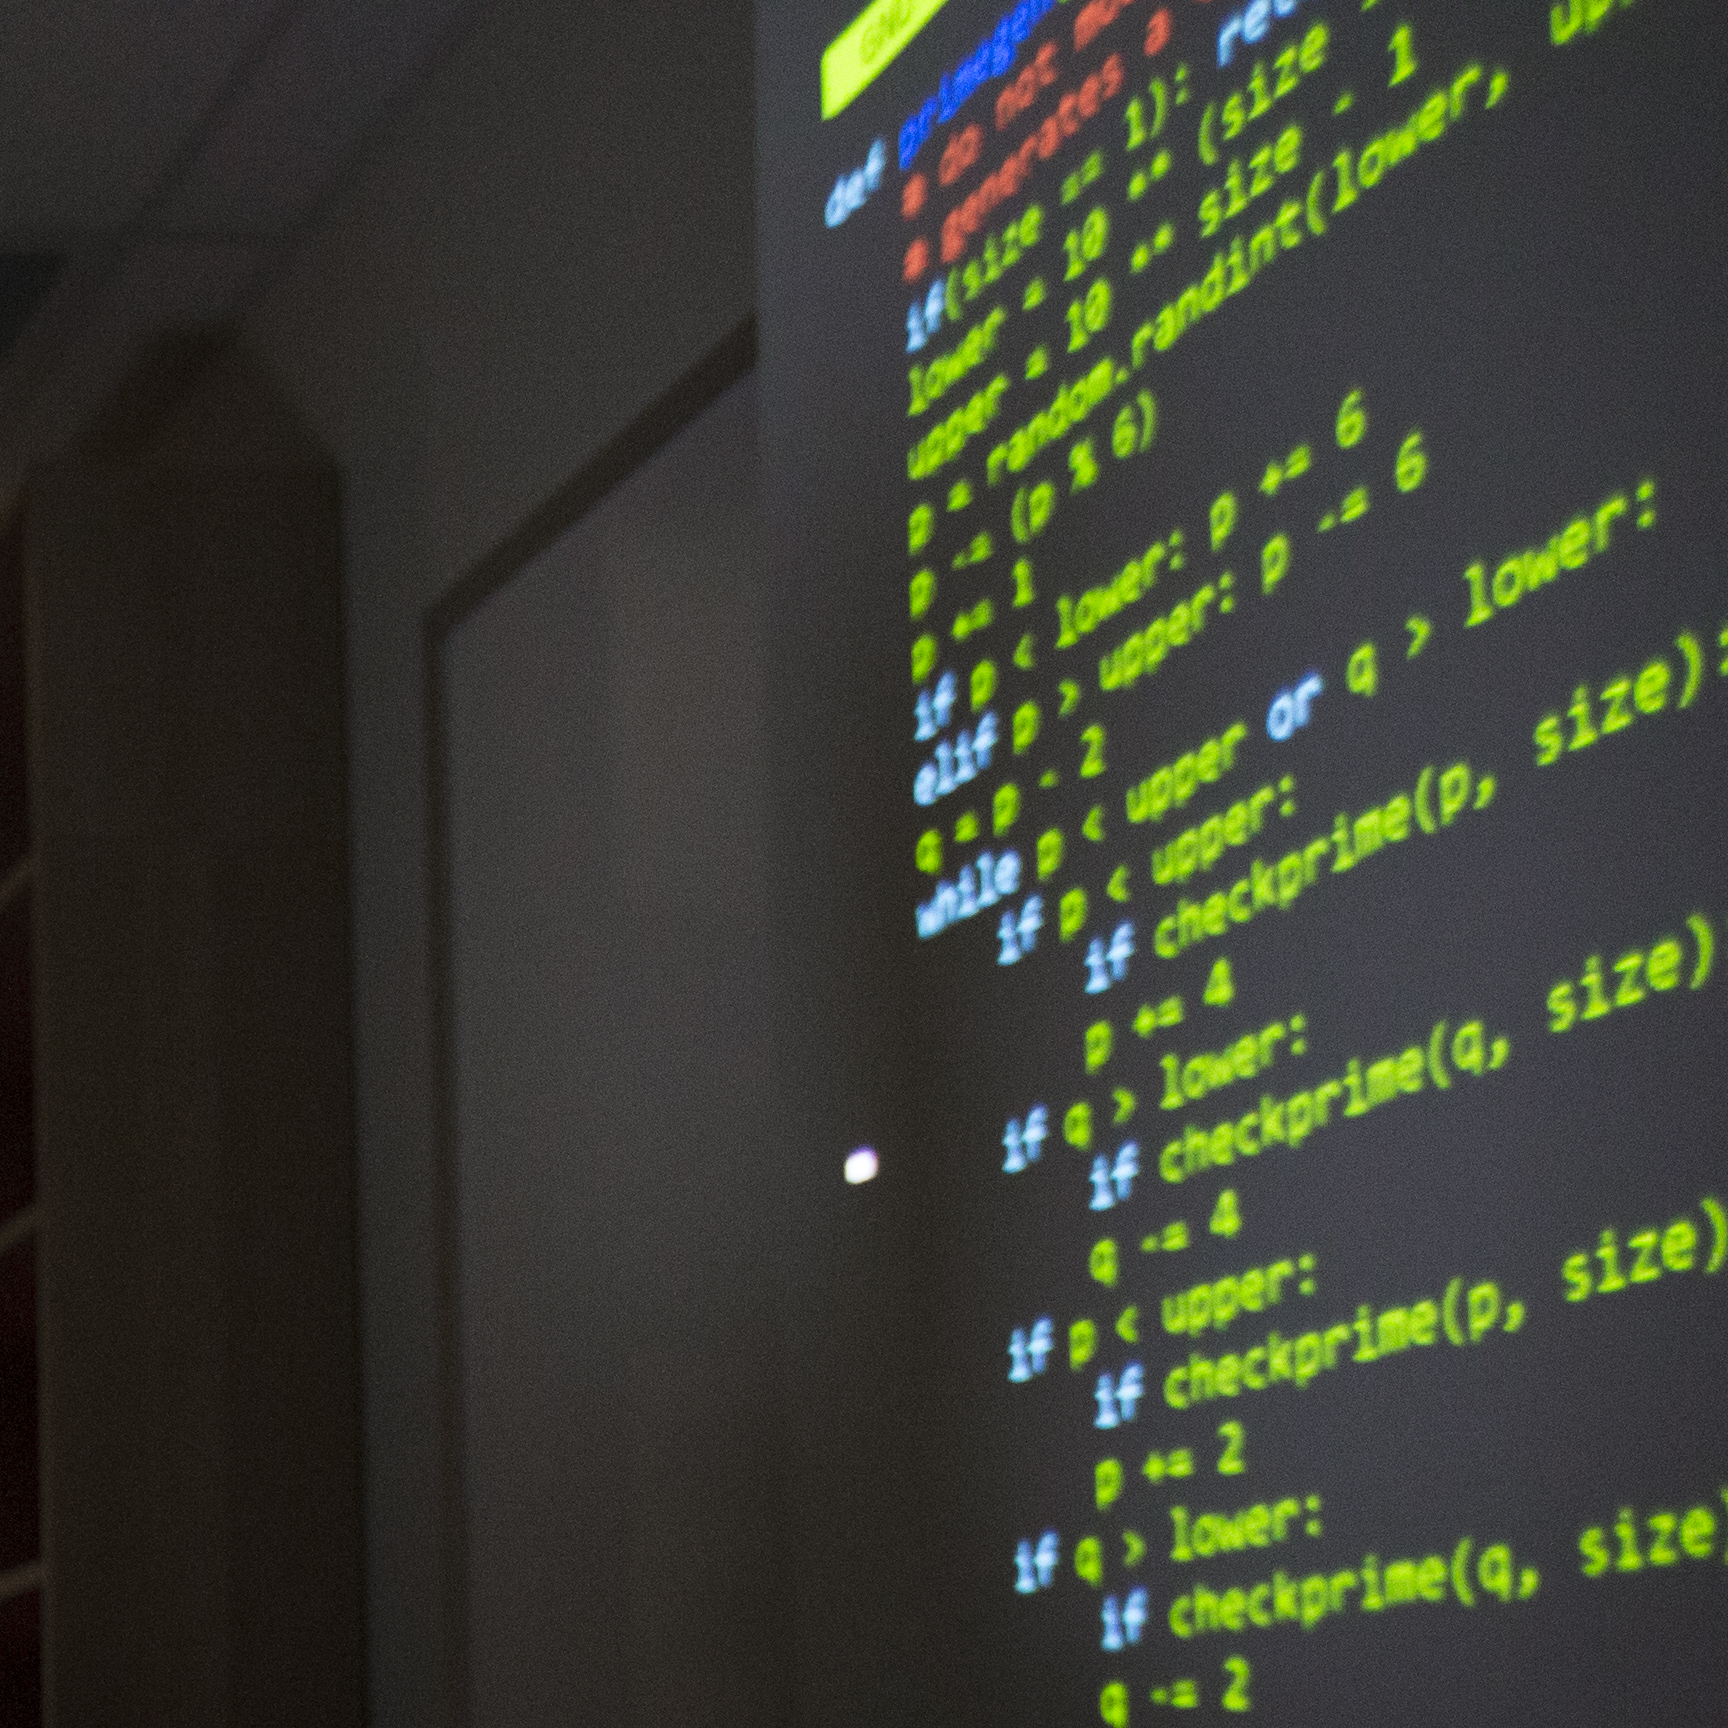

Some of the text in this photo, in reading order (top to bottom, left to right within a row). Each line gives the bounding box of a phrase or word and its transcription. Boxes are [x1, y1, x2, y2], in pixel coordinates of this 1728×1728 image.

[822, 135, 889, 231] def
[905, 304, 1008, 418] lower
[1061, 205, 1111, 283] 10
[1196, 20, 1331, 167] (size
[905, 372, 1011, 482] upper
[1063, 276, 1114, 355] 10
[1196, 120, 1305, 239] size
[1386, 22, 1420, 89] 1
[905, 501, 936, 556] p
[906, 566, 938, 621] p
[1008, 479, 1057, 545] (p
[1109, 388, 1158, 460] 6)
[912, 670, 958, 744] if
[967, 657, 999, 713] p
[1053, 528, 1186, 651] lower:
[1207, 489, 1240, 553] p
[1333, 387, 1368, 451] 6
[908, 631, 939, 685] p
[1009, 556, 1037, 610] 1
[911, 709, 1000, 808] elif
[1009, 698, 1042, 756] p
[1097, 570, 1237, 694] upper:
[1259, 531, 1292, 595] p
[1392, 430, 1429, 495] 6
[914, 847, 1023, 940] while
[1033, 825, 1066, 882] p
[1123, 720, 1249, 826] upper
[1263, 667, 1326, 744] or
[1344, 640, 1380, 698] q
[1461, 478, 1657, 630] lower:
[990, 781, 1023, 838] p
[1077, 722, 1108, 781] 2
[995, 892, 1045, 968] if
[1056, 885, 1089, 943] p
[1149, 773, 1297, 888] upper:
[1082, 917, 1137, 997] if
[1152, 760, 1498, 961] checkprime(p,
[1000, 1102, 1050, 1175] if
[1061, 1099, 1094, 1152] q
[1158, 1011, 1309, 1112] lower:
[1082, 1018, 1115, 1076] p
[1200, 955, 1237, 1009] 4
[1087, 912, 1716, 1214] if checkprime(q, size)
[1006, 1314, 1056, 1385] if
[1066, 1317, 1099, 1371] p
[1159, 1251, 1318, 1339] upper:
[1086, 1236, 1121, 1288] q
[1207, 1186, 1244, 1240] 4
[1092, 1195, 1728, 1431] if checkprime(p, size)
[1012, 1528, 1061, 1596] if
[1072, 1534, 1105, 1588] q
[1168, 1492, 1324, 1565] lower:
[1092, 1456, 1125, 1511] p
[1215, 1418, 1247, 1478] 2
[1099, 1487, 1728, 1653] if checkprime(q, size
[1219, 1654, 1252, 1714] 2
